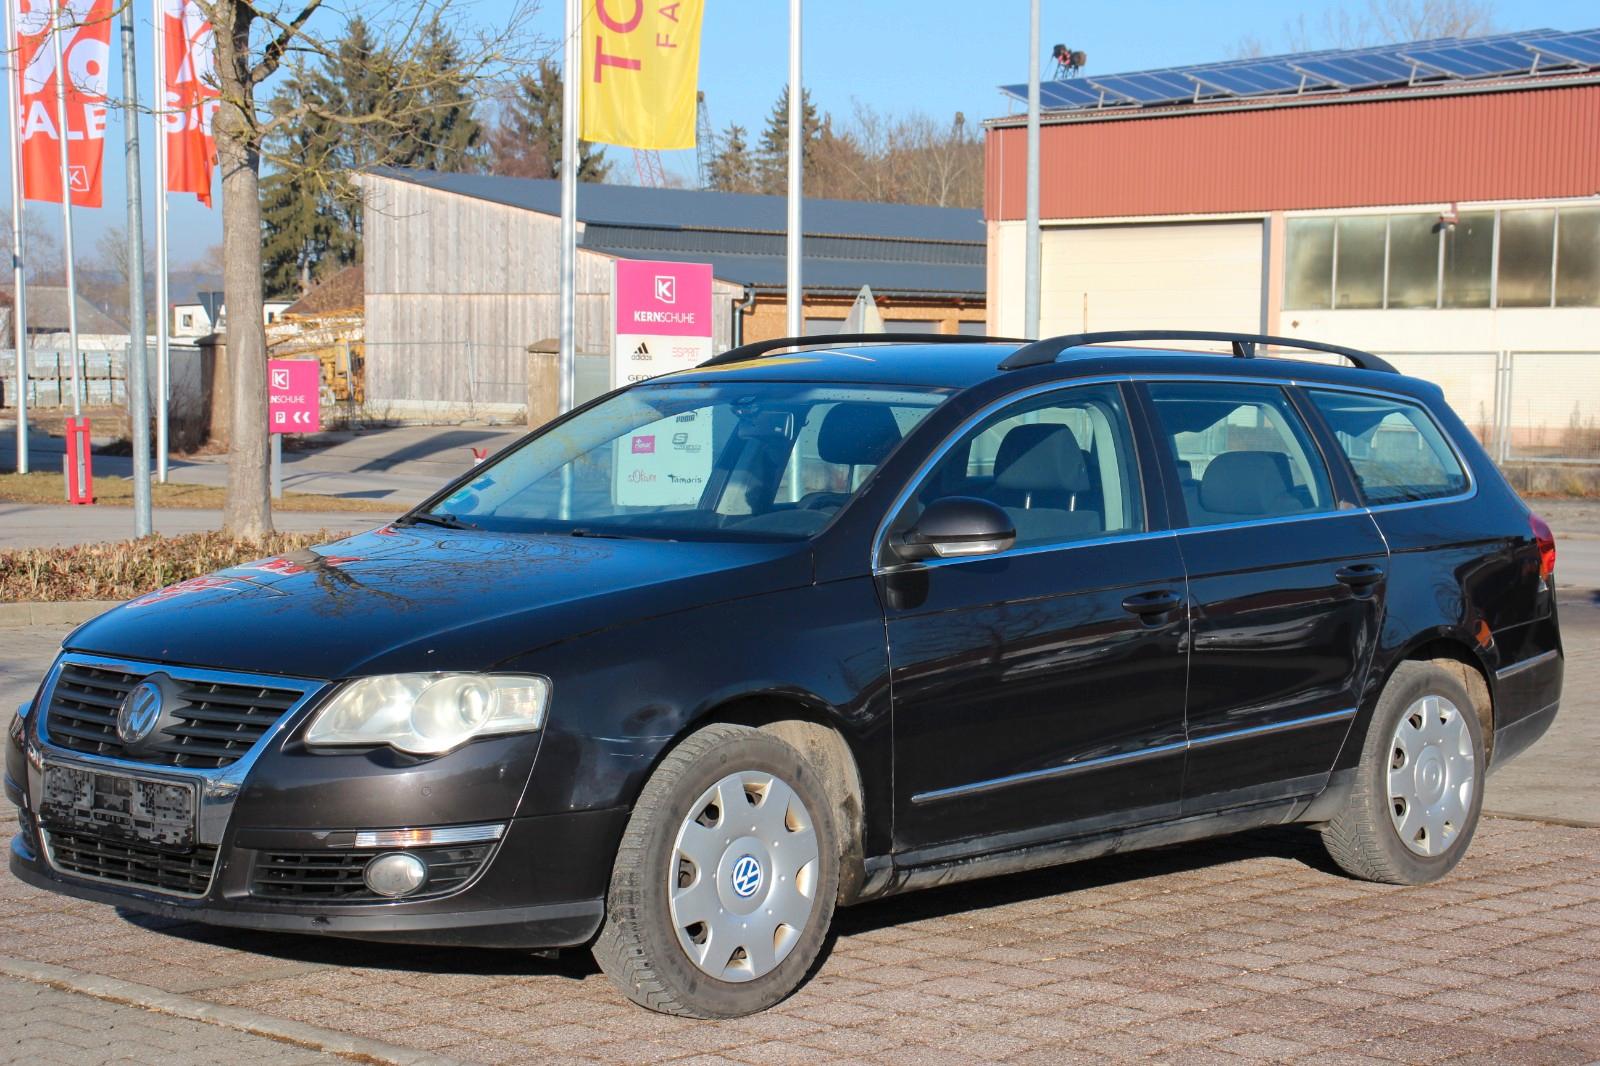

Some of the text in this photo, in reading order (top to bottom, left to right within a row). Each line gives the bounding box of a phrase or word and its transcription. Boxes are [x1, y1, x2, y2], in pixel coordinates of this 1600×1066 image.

[633, 310, 695, 324] KERNSCHUHE
[631, 353, 653, 361] adidas
[672, 347, 701, 358] ESPRIT
[270, 395, 305, 404] NSCHUHE
[667, 474, 702, 484] Tamaris
